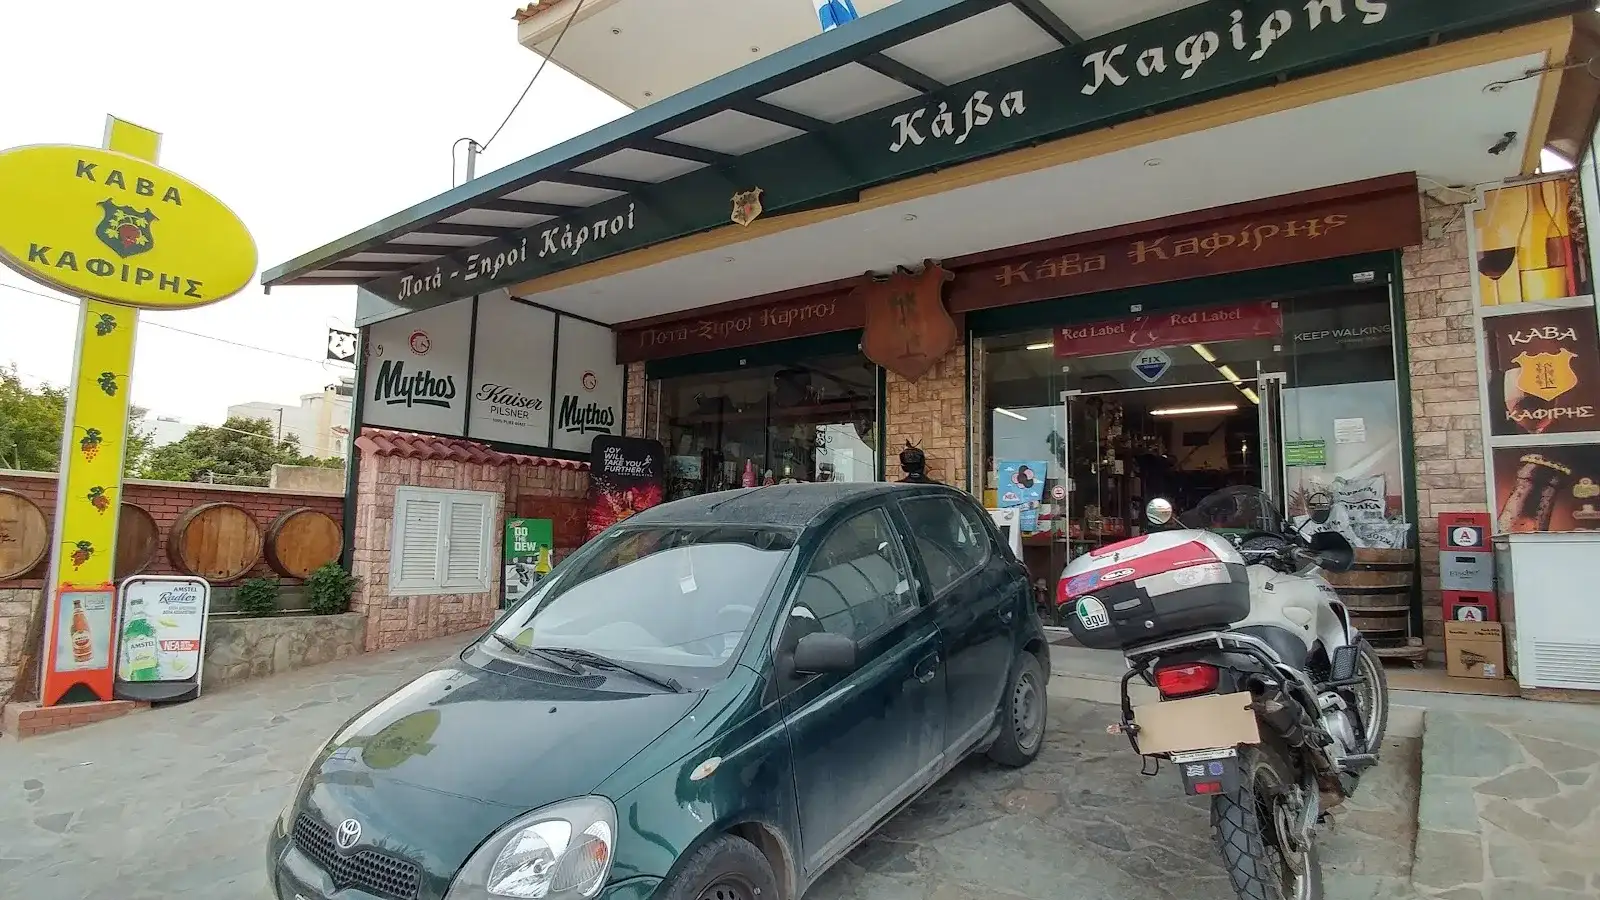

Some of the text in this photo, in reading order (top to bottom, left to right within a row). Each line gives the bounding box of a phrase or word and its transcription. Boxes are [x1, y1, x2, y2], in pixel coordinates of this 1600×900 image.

[889, 86, 1027, 153] Κάβα
[76, 159, 183, 206] ΚΑΒΑ
[27, 243, 204, 298] ΚΑΦΙΡΗΣ
[397, 267, 442, 300] Ποτά
[464, 238, 527, 281] Ξηροί
[1171, 309, 1241, 326] Red Label
[1064, 323, 1125, 341] Red Label
[1293, 330, 1330, 342] KEEP
[1331, 324, 1391, 338] WALKING
[1508, 326, 1578, 345] ΚΑΒΑ
[374, 360, 456, 407] Mythos
[476, 383, 543, 411] Kaiser
[490, 405, 529, 419] PILSNER
[558, 395, 614, 434] Mythos
[1505, 406, 1595, 421] ΚΑΦΙΡΗΣ
[604, 446, 621, 454] JOY
[604, 459, 642, 468] TAKE YOU
[514, 526, 528, 536] DO
[514, 542, 537, 552] DEW
[159, 591, 197, 604] Radler
[130, 641, 155, 650] AMSTEL
